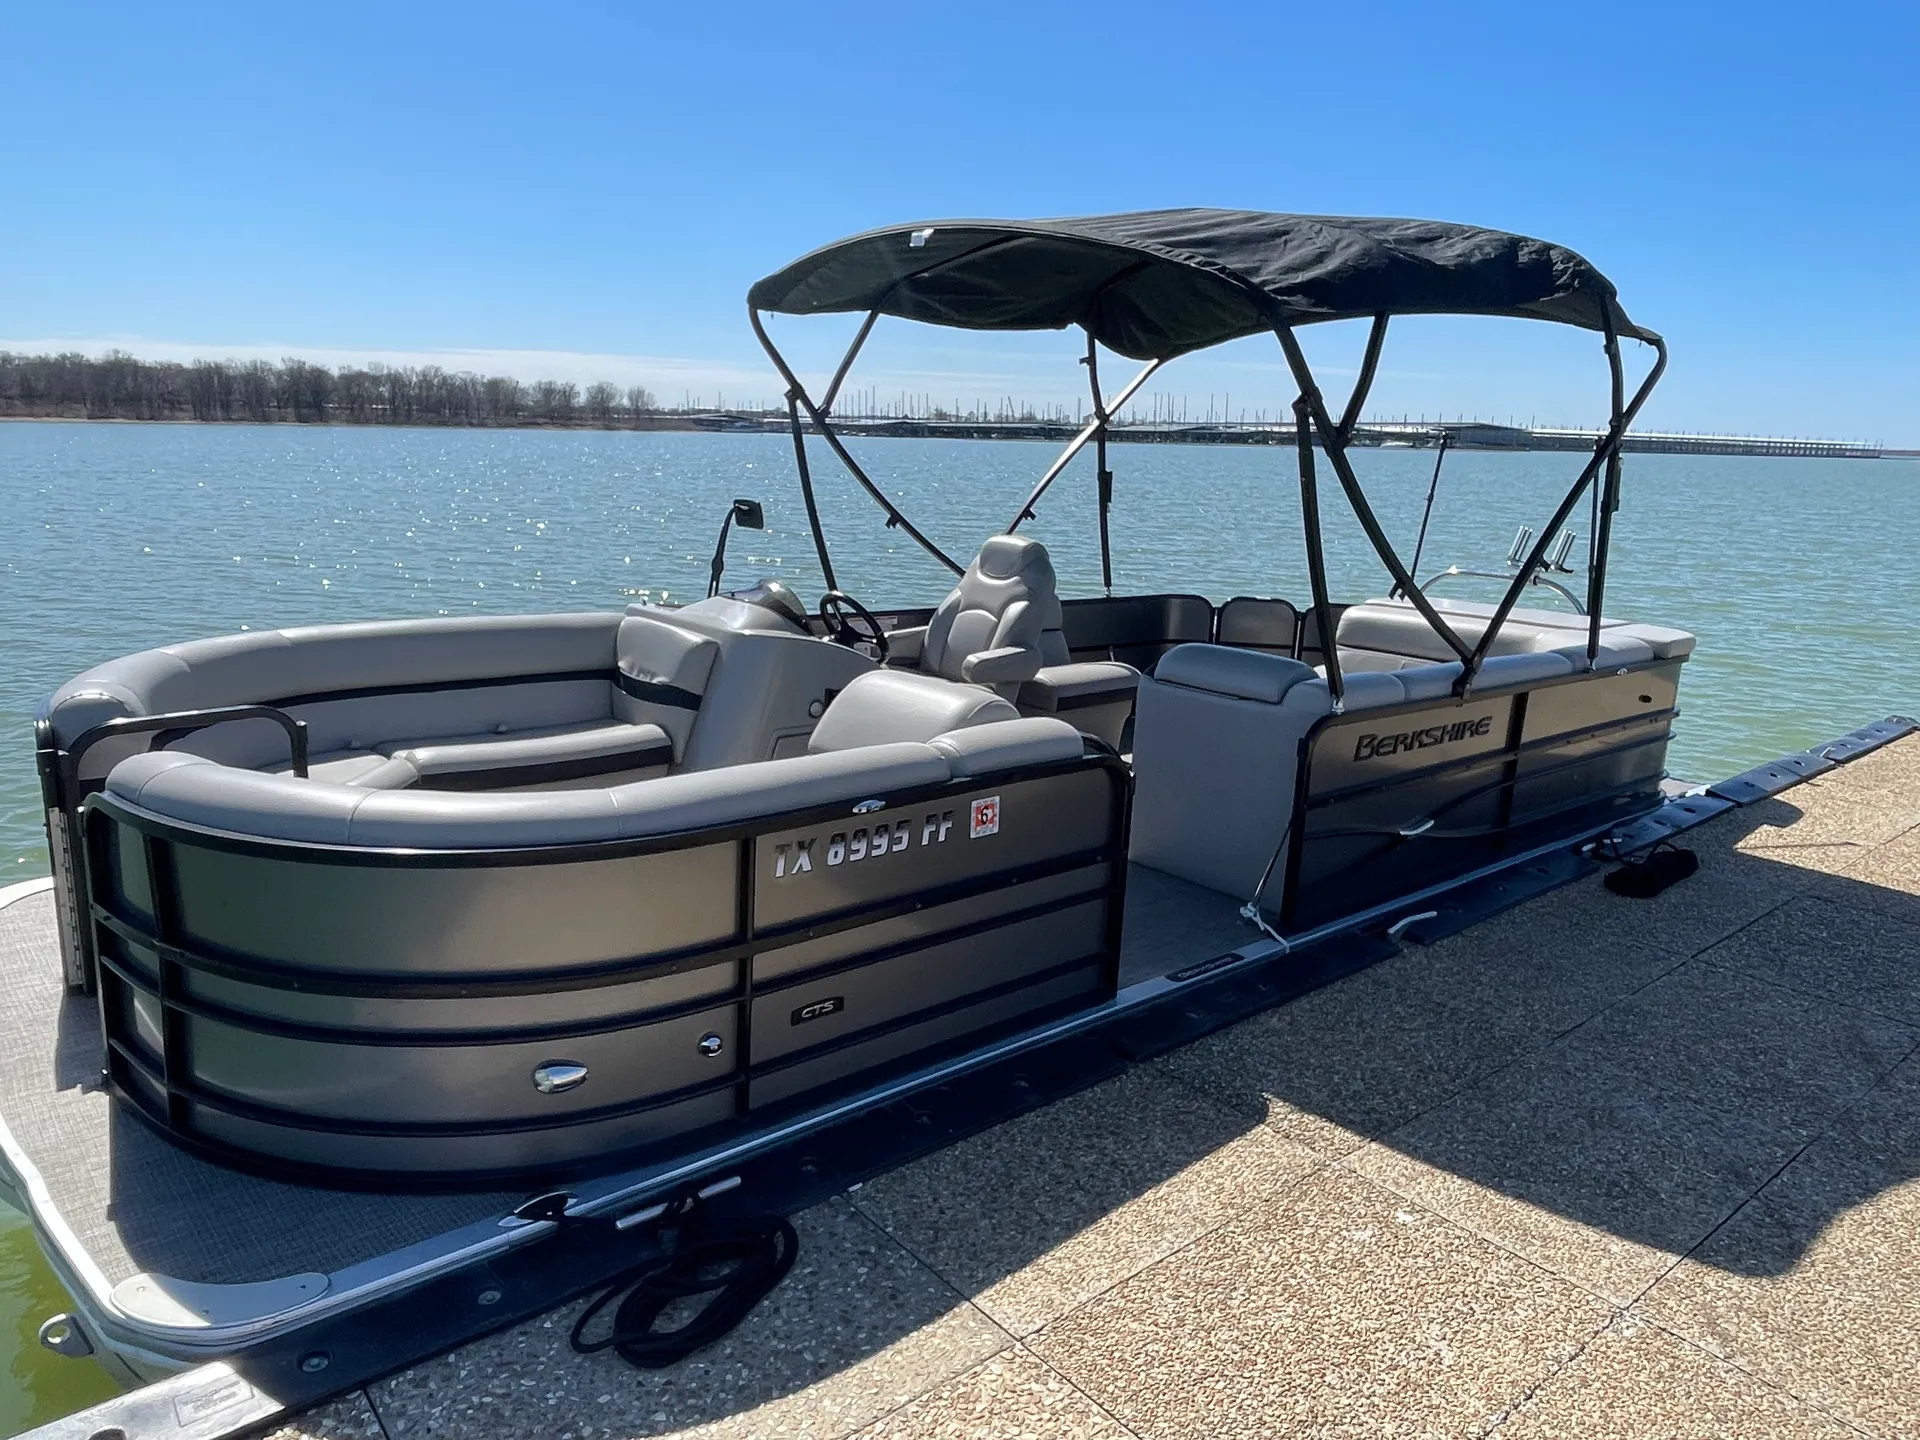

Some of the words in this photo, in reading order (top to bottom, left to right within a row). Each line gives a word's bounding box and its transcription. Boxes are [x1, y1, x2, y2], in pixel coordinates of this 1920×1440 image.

[1353, 716, 1493, 762] BERKSHIRE
[980, 805, 989, 826] 6
[774, 837, 817, 878] TX
[827, 820, 911, 867] 8995
[920, 810, 954, 846] FF
[801, 1000, 834, 1018] CTS
